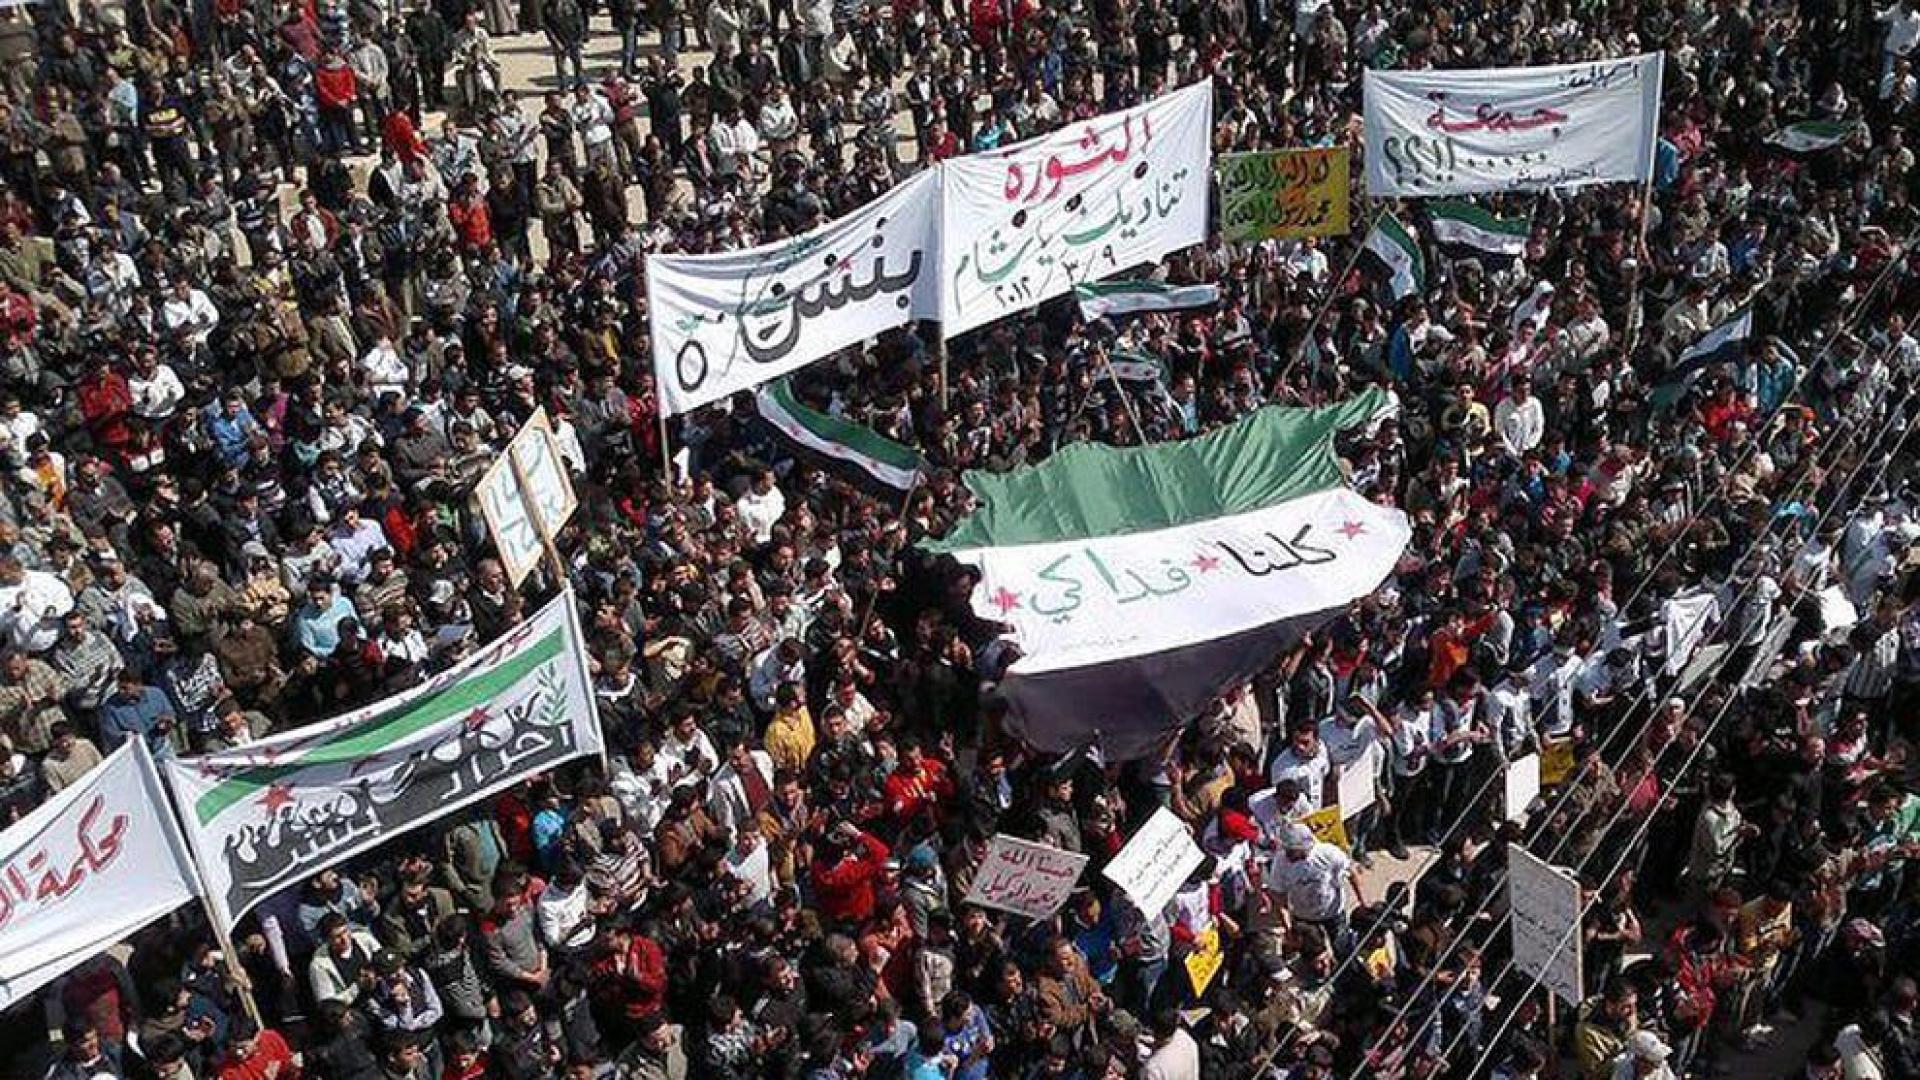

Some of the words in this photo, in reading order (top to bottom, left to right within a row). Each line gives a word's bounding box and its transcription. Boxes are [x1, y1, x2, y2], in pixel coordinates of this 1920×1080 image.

[1427, 91, 1569, 138] جمعة
[1005, 112, 1152, 209] الثورة
[1062, 168, 1188, 246] تناديك
[1030, 546, 1191, 623] فداكي
[1216, 523, 1337, 577] كلنا
[27, 792, 130, 904] محكمة
